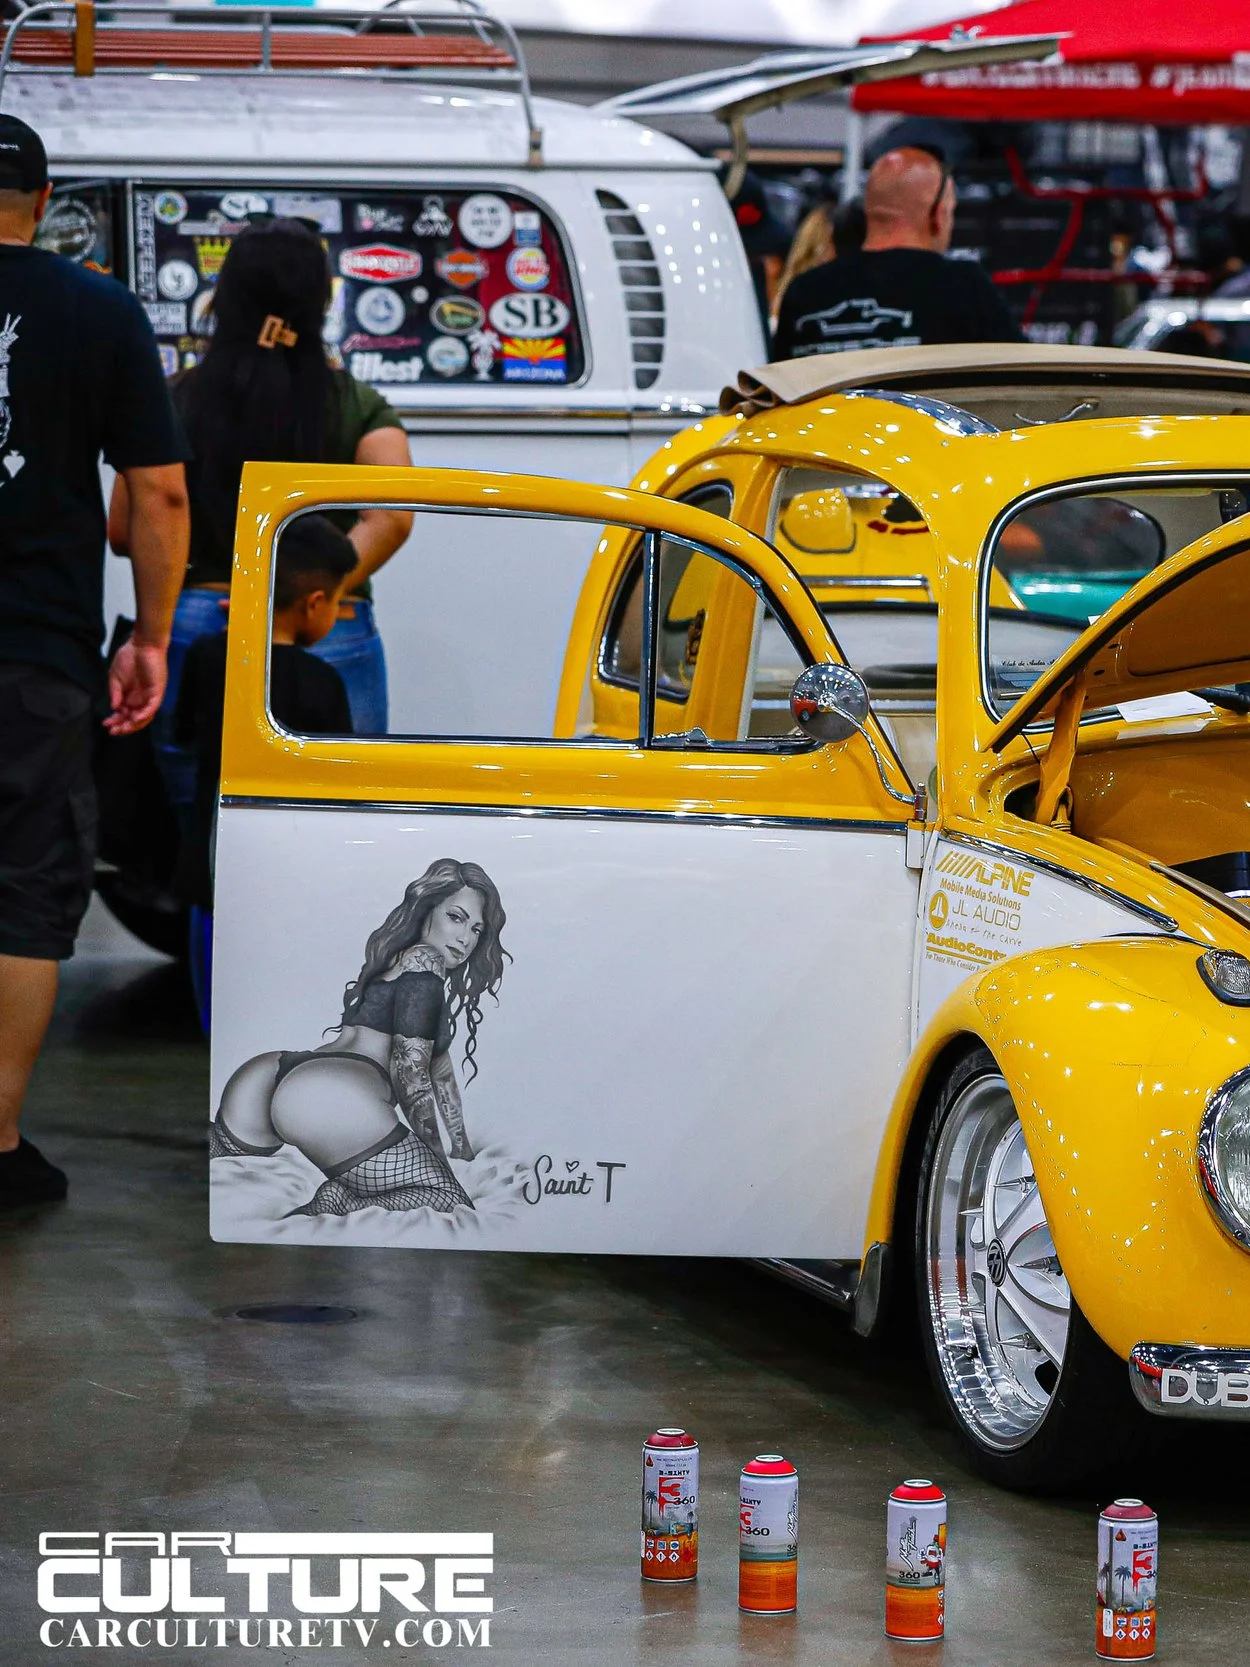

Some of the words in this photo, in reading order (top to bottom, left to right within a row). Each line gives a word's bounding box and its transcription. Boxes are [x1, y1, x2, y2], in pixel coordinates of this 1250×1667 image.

[503, 299, 560, 329] SB
[936, 850, 1035, 896] ALPINE
[940, 878, 963, 893] Mobile
[965, 885, 987, 901] Media
[988, 892, 1022, 911] Solutions
[952, 899, 968, 917] JL
[972, 904, 1021, 931] AUDIO
[522, 1154, 594, 1205] Saint
[596, 1161, 626, 1203] T
[673, 1495, 696, 1506] 360
[745, 1526, 770, 1537] 360
[899, 1571, 920, 1579] 360
